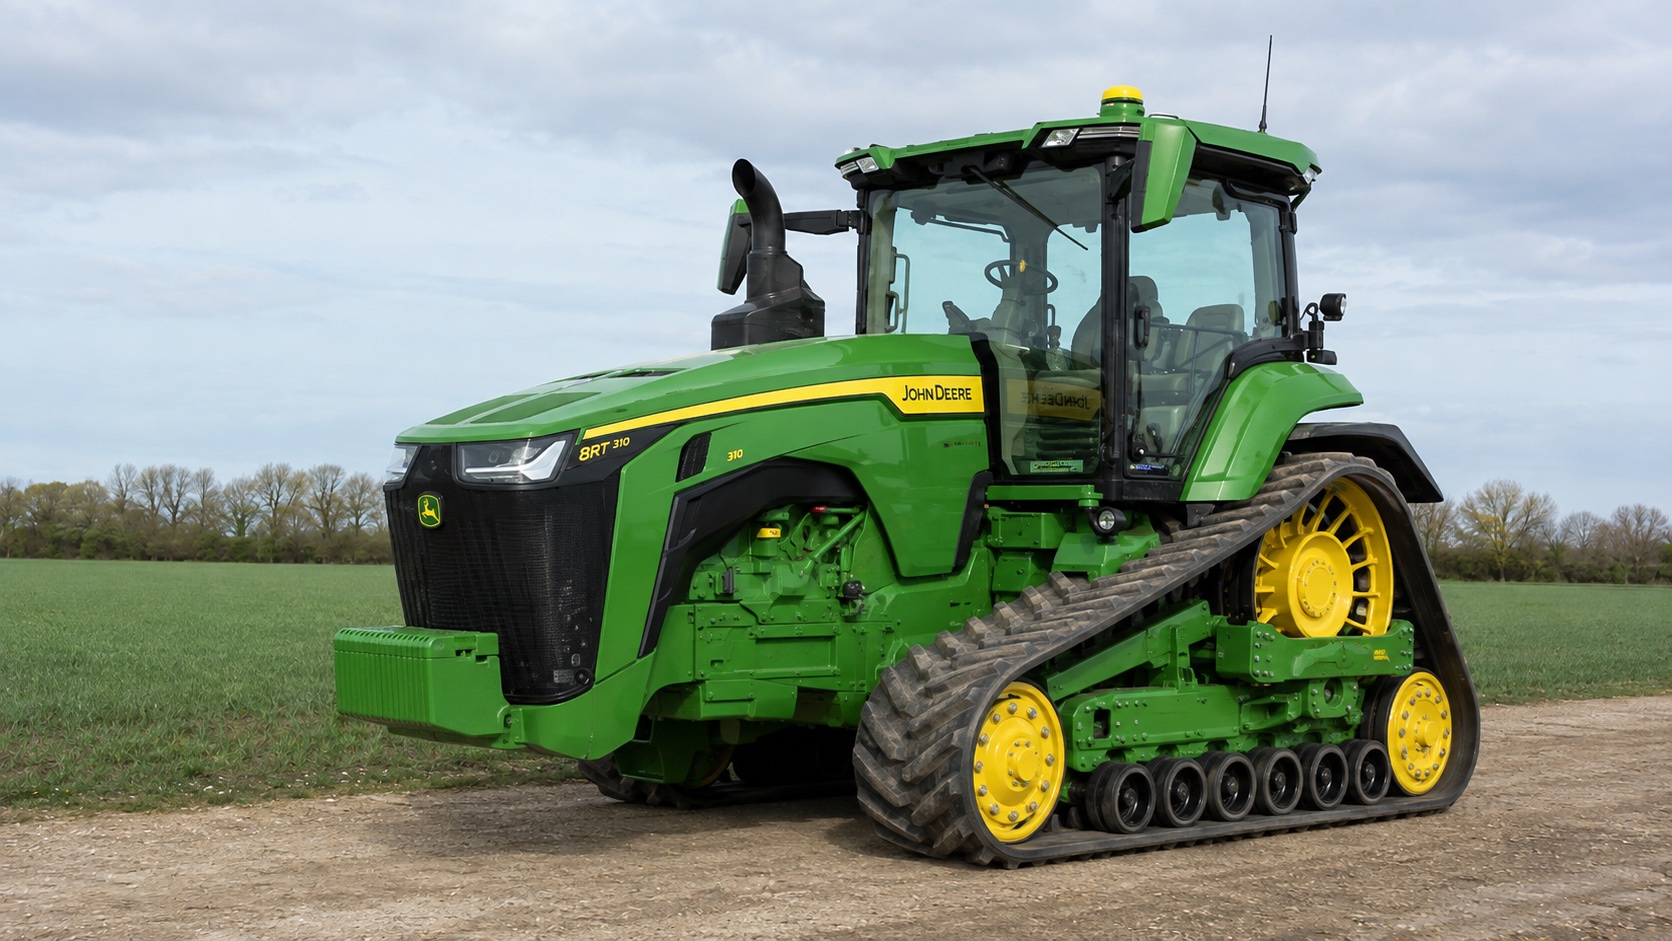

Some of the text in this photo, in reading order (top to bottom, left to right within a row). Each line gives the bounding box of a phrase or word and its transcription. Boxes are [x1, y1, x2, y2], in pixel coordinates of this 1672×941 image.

[902, 384, 972, 401] JOHN DEERE
[578, 437, 631, 462] 8RT 310
[726, 449, 744, 462] 310
